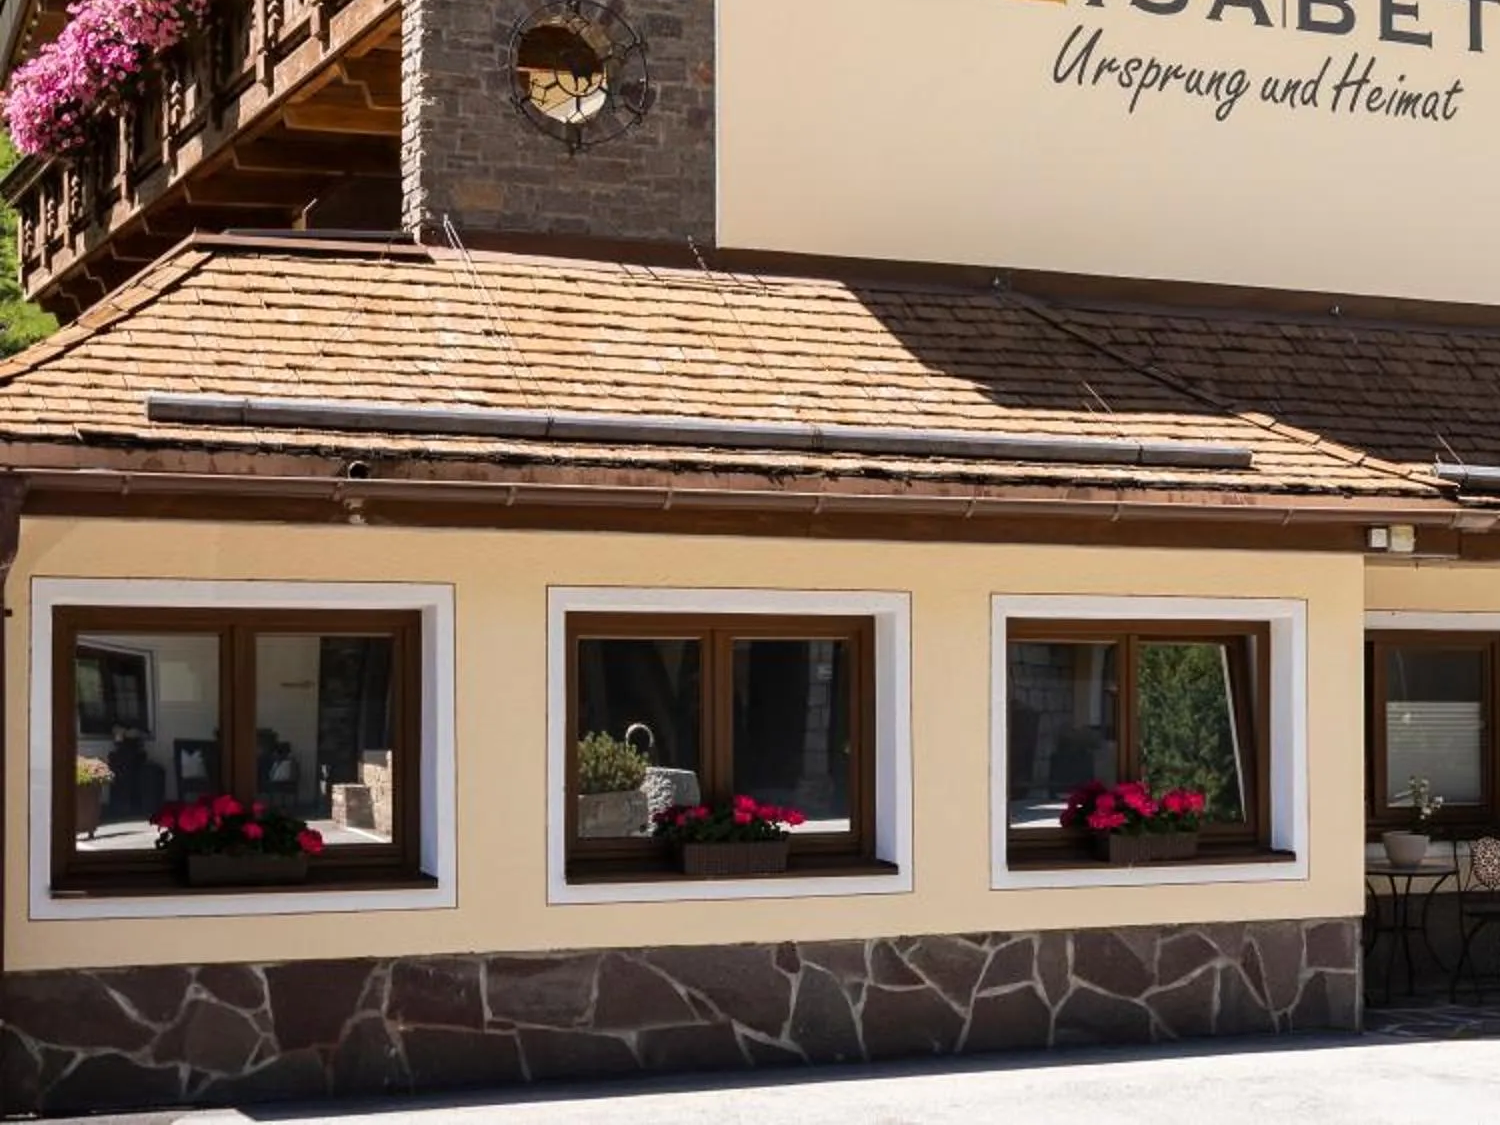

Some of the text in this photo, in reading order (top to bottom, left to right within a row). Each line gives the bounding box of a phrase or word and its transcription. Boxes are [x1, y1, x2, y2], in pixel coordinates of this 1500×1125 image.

[1053, 24, 1465, 122] Ursprung und Heimat
